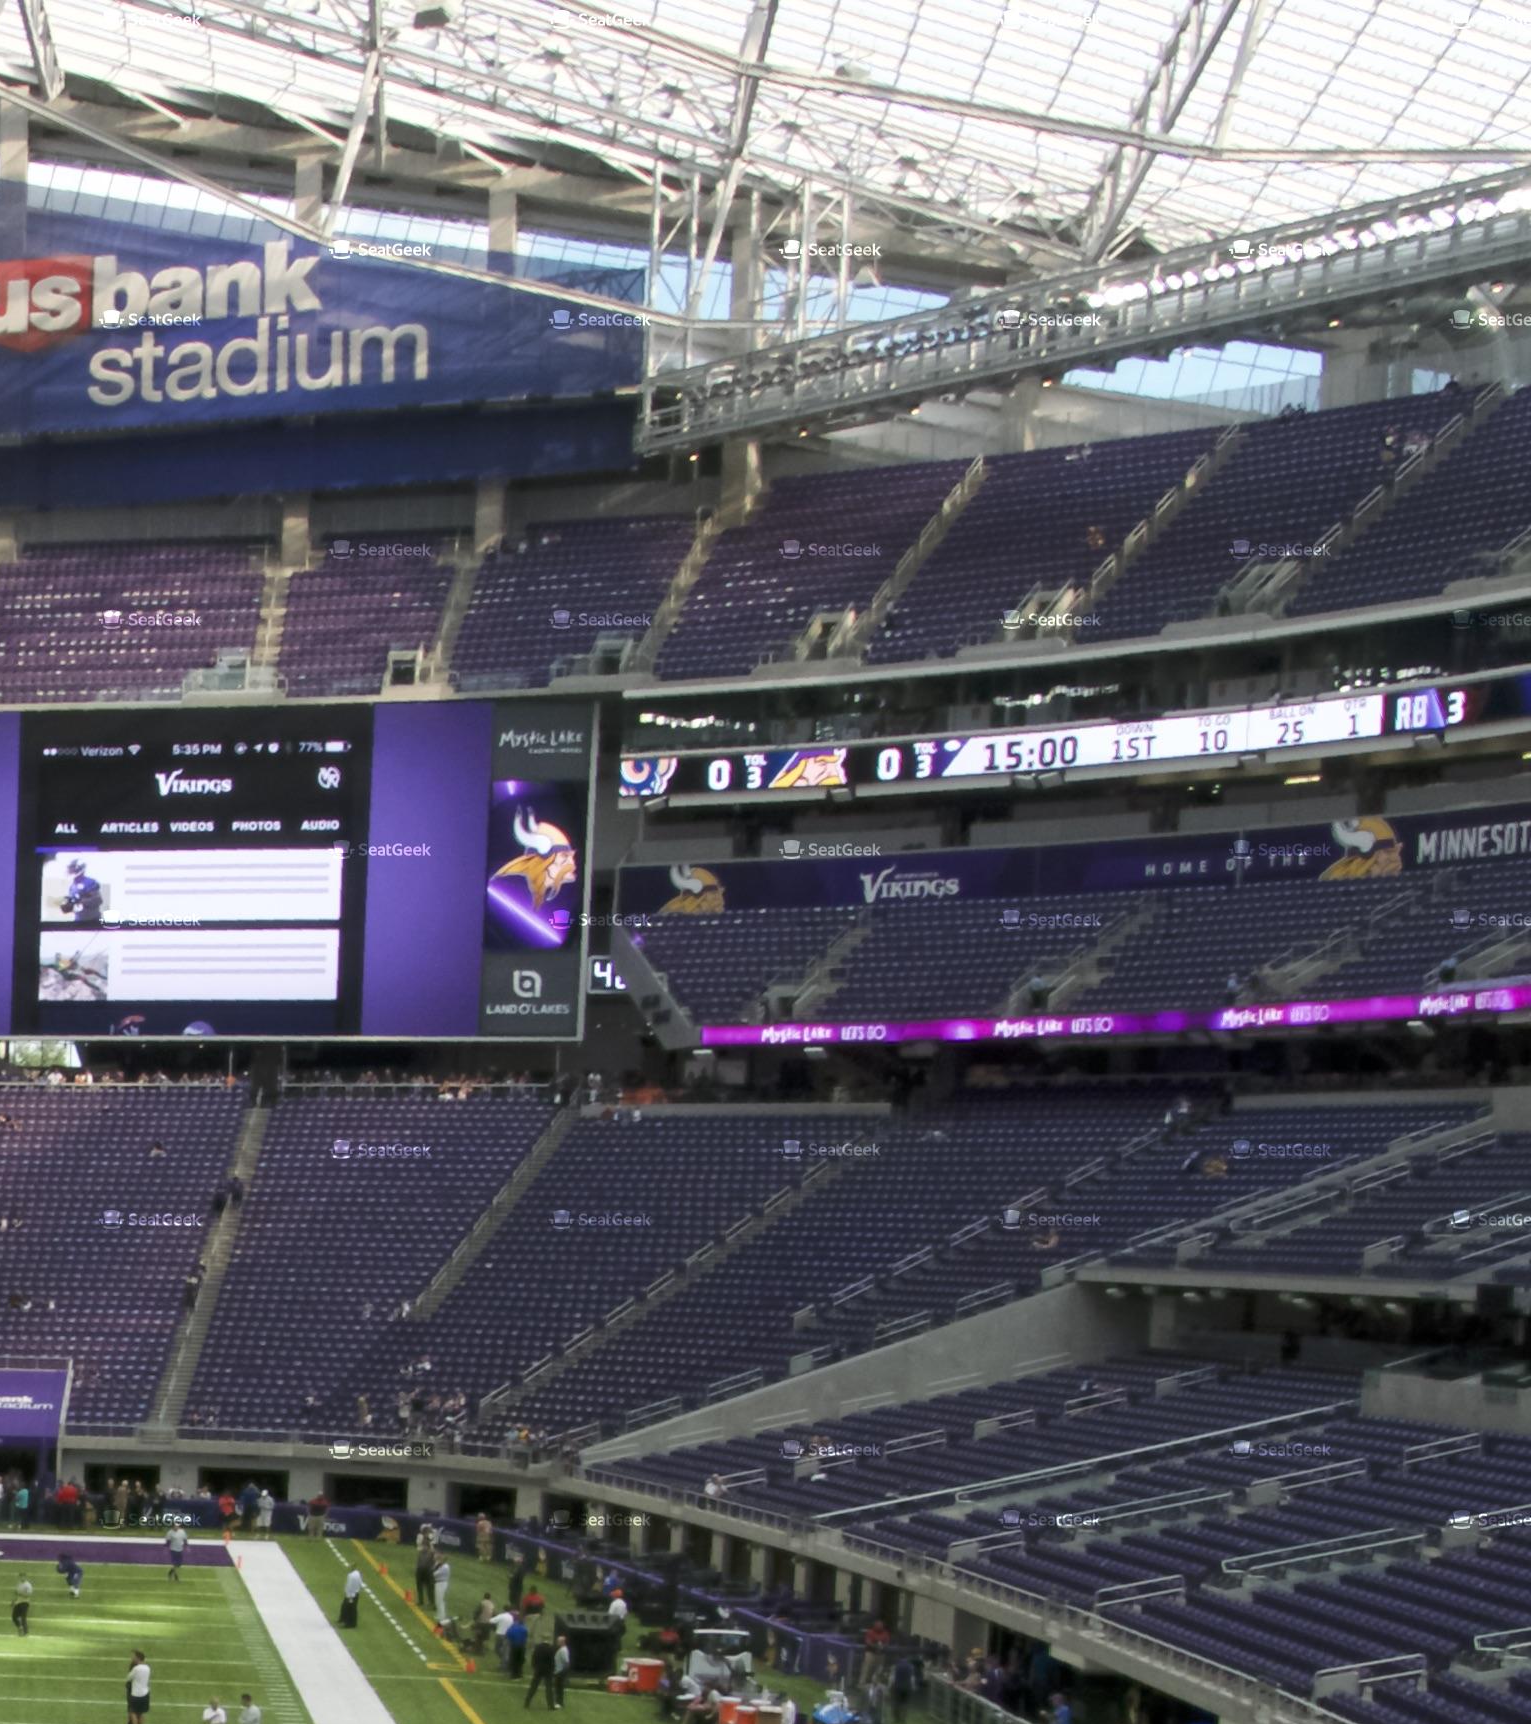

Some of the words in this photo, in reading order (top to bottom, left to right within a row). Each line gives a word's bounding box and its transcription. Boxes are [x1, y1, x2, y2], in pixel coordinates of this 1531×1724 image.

[88, 315, 429, 406] stadium
[1446, 690, 1467, 724] 3
[1277, 720, 1305, 744] 25
[1347, 714, 1361, 736] 1
[80, 745, 123, 757] Verizon
[201, 744, 222, 756] PM
[299, 741, 323, 753] 77%
[984, 735, 1079, 772] 15:00
[1112, 736, 1157, 761] 1ST
[1199, 731, 1228, 754] 10
[708, 759, 732, 791] 0
[877, 749, 901, 781] 0
[915, 756, 931, 778] 3
[746, 767, 762, 789] 3
[55, 823, 78, 834] ALL
[100, 822, 159, 834] ARTICLES
[170, 821, 214, 833] VIDEOS
[232, 820, 281, 832] PHOTOS
[301, 819, 340, 831] AUDIO
[1416, 819, 1531, 865] MINNESOT
[1145, 859, 1208, 877] HOME
[1268, 850, 1308, 868] THE
